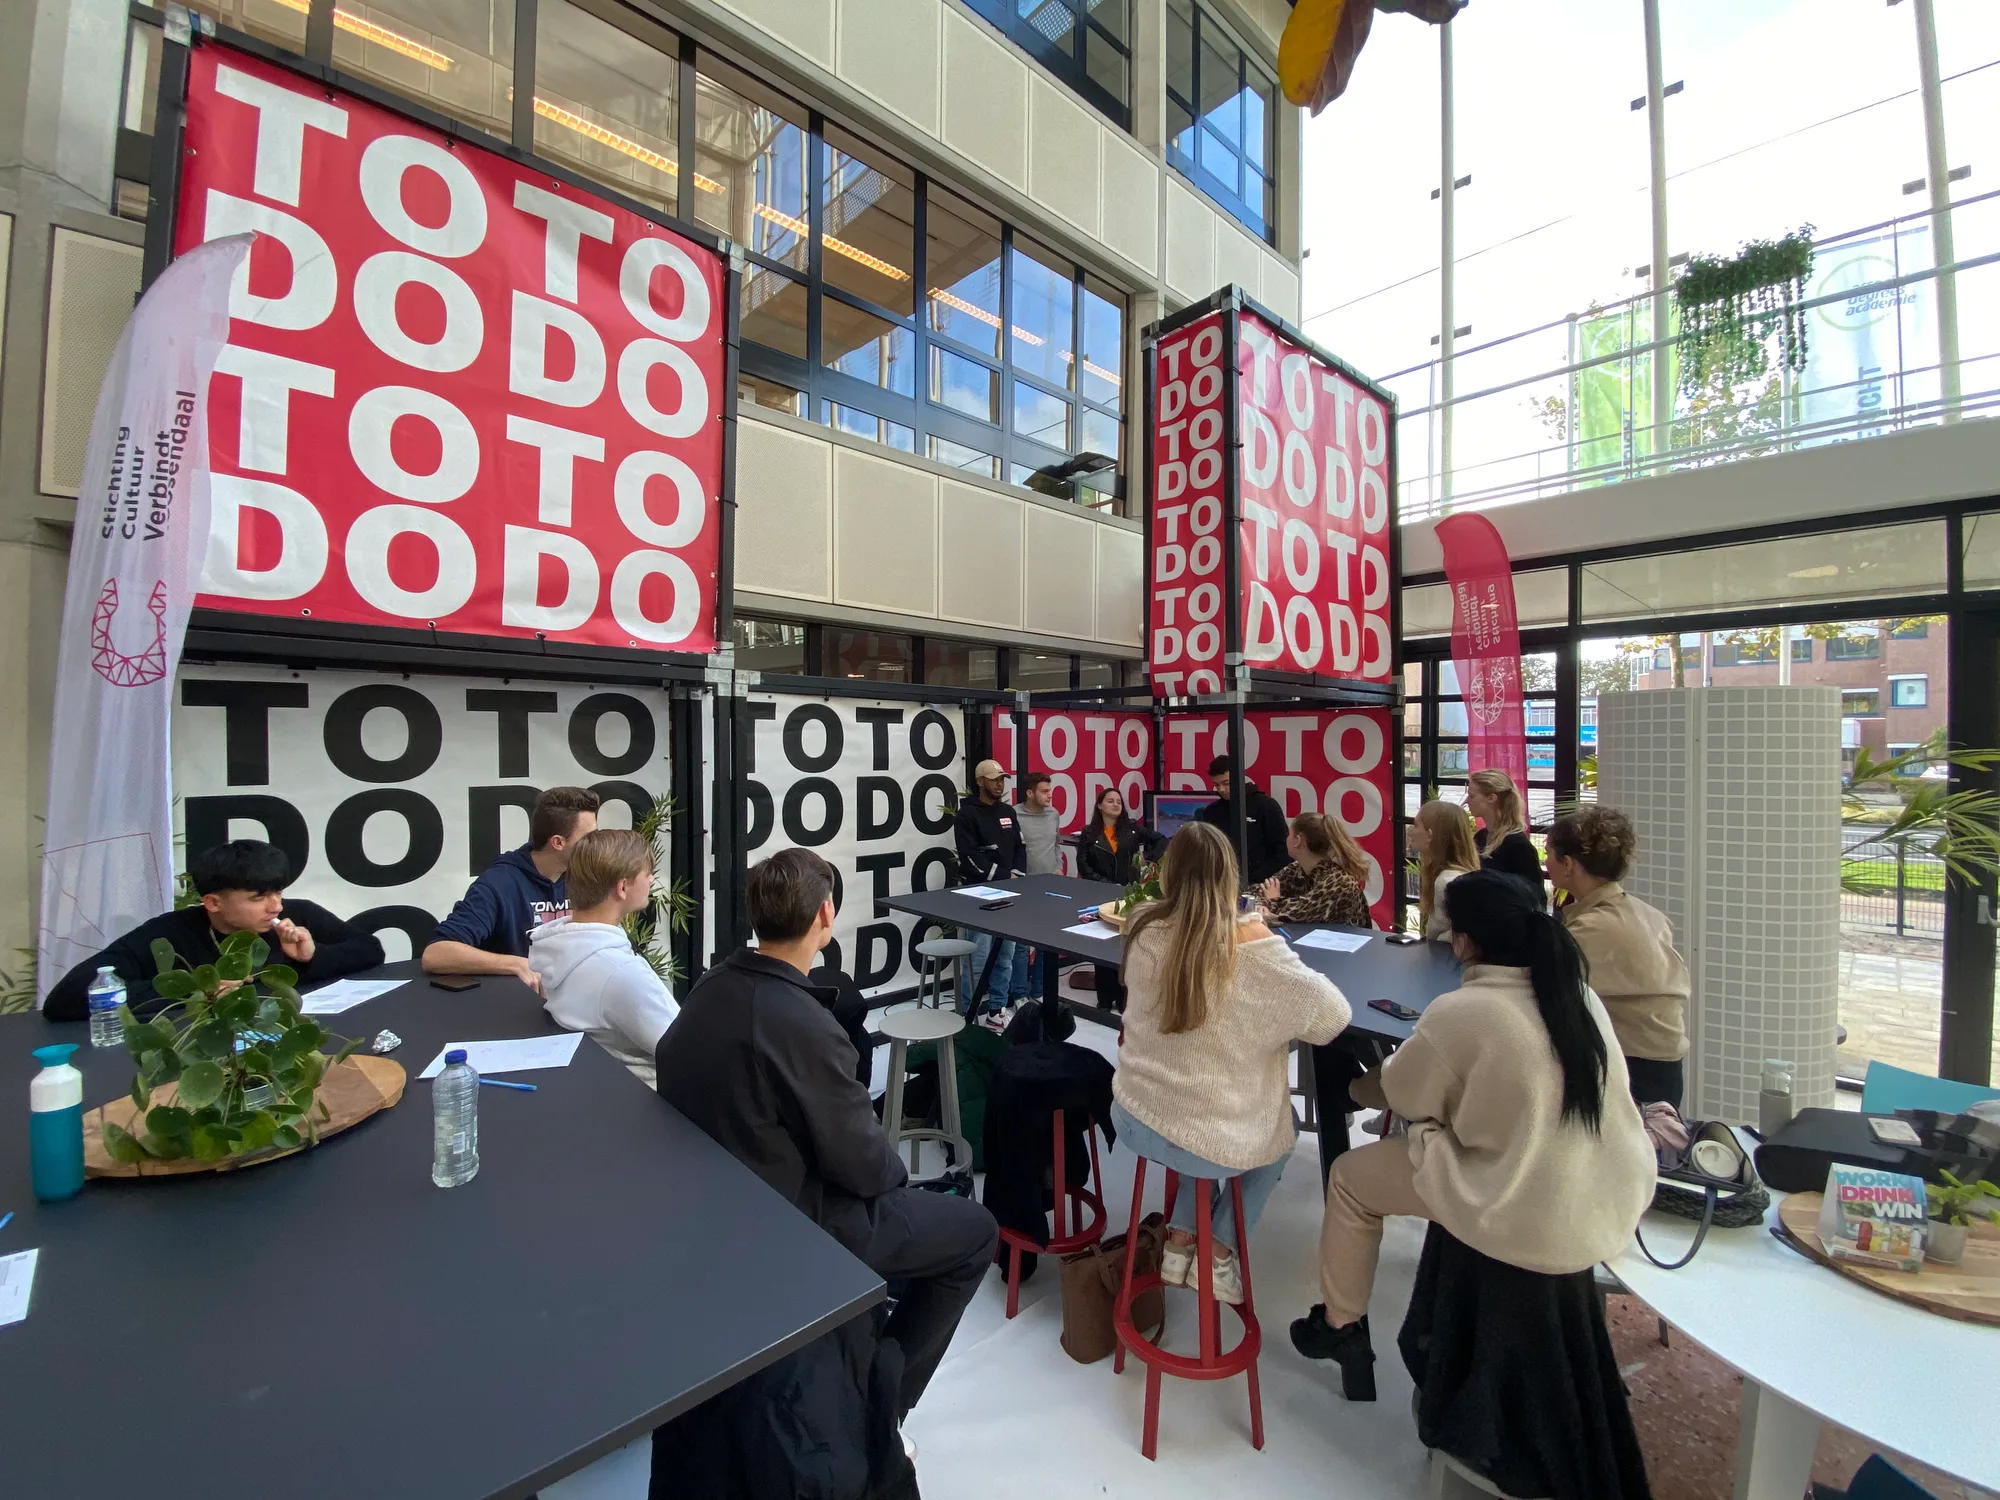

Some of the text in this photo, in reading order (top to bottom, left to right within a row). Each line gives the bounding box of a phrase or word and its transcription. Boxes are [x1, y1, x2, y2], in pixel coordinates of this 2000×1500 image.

[214, 63, 711, 342] TO TO
[1845, 294, 1917, 316] academie
[510, 289, 709, 439] DO
[1161, 325, 1223, 381] TO
[1160, 365, 1223, 422] DO
[212, 341, 706, 549] TO TO
[1159, 408, 1223, 461] TO
[102, 426, 131, 540] Stichting
[121, 446, 145, 540] Cultuur
[143, 431, 170, 541] Verbindt
[1158, 449, 1223, 500] DO
[1157, 496, 1222, 543] TO
[502, 523, 701, 644] DO
[1156, 536, 1221, 583] DO
[1154, 582, 1221, 626] TO
[1153, 623, 1221, 664] DO
[181, 682, 657, 786] TO TO
[856, 707, 957, 771] TO
[1085, 718, 1149, 769] TO
[1270, 714, 1384, 775] TO
[857, 774, 958, 841] DO
[1841, 1186, 1916, 1203] DRINK
[1872, 1202, 1923, 1219] WIN
